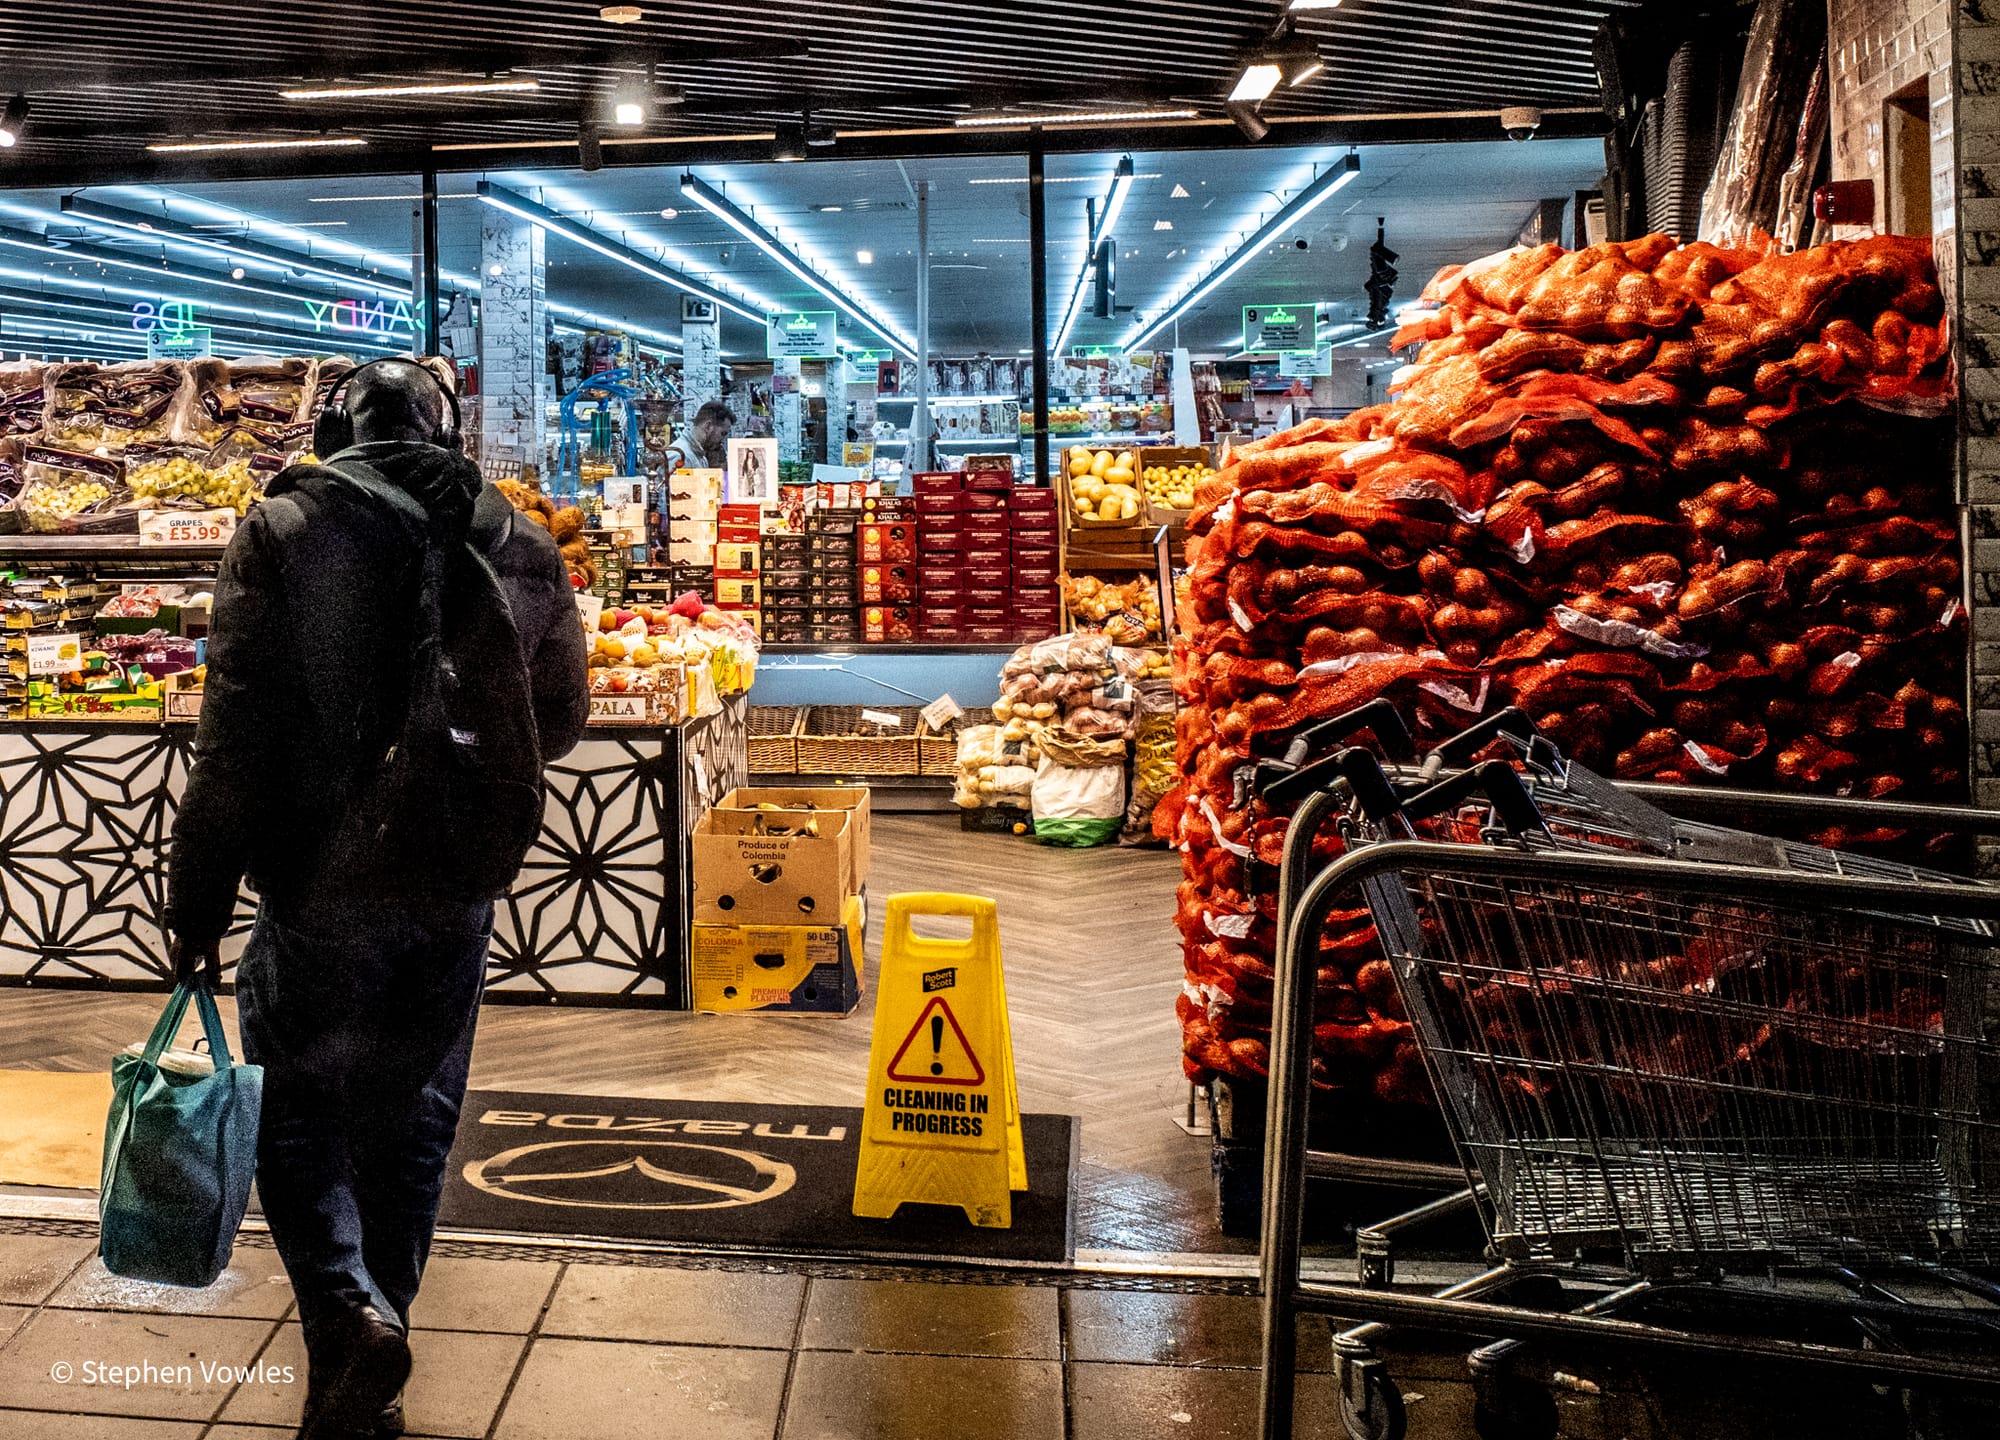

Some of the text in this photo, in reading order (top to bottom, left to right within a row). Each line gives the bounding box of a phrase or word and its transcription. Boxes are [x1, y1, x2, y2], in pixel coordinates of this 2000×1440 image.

[1248, 310, 1257, 322] 9
[772, 317, 780, 329] 7
[152, 333, 160, 345] 3
[1075, 347, 1086, 357] 10
[169, 519, 203, 527] GRAPES
[169, 526, 220, 541] £5.99
[33, 659, 55, 669] £1.99
[738, 841, 790, 850] Produce of
[742, 851, 786, 860] Colombia
[806, 932, 836, 941] 50 LBS
[924, 970, 953, 983] Robert
[930, 978, 953, 990] Scott
[884, 1088, 989, 1114] CLEANING IN
[892, 1111, 983, 1137] PROGRESS
